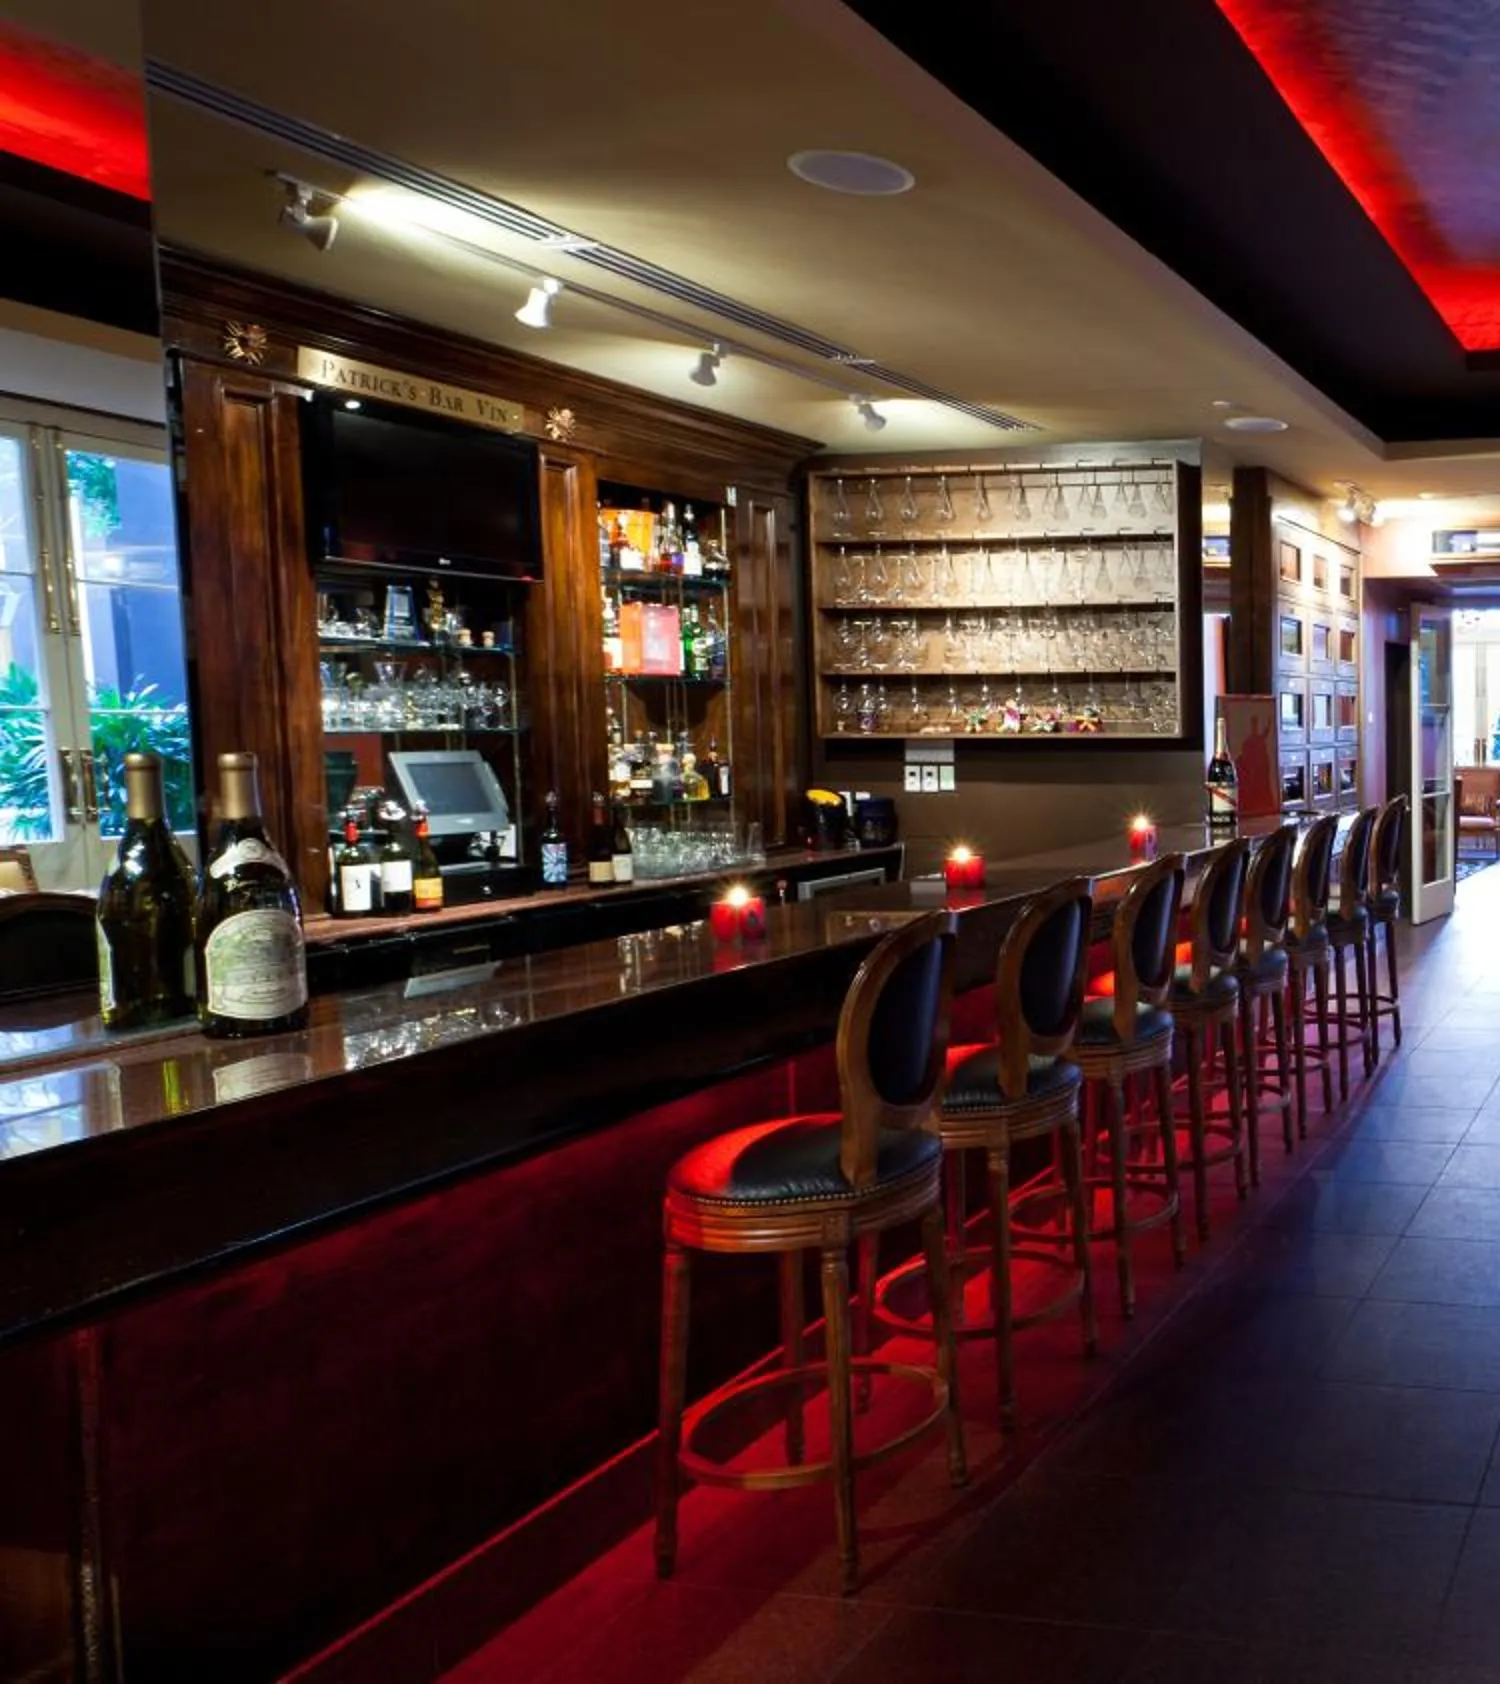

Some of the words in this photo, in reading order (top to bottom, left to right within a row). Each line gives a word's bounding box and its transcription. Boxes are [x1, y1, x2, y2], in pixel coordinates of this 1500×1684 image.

[320, 359, 417, 401] PATRICK'S
[429, 386, 464, 413] BAR
[477, 398, 509, 423] VIN
